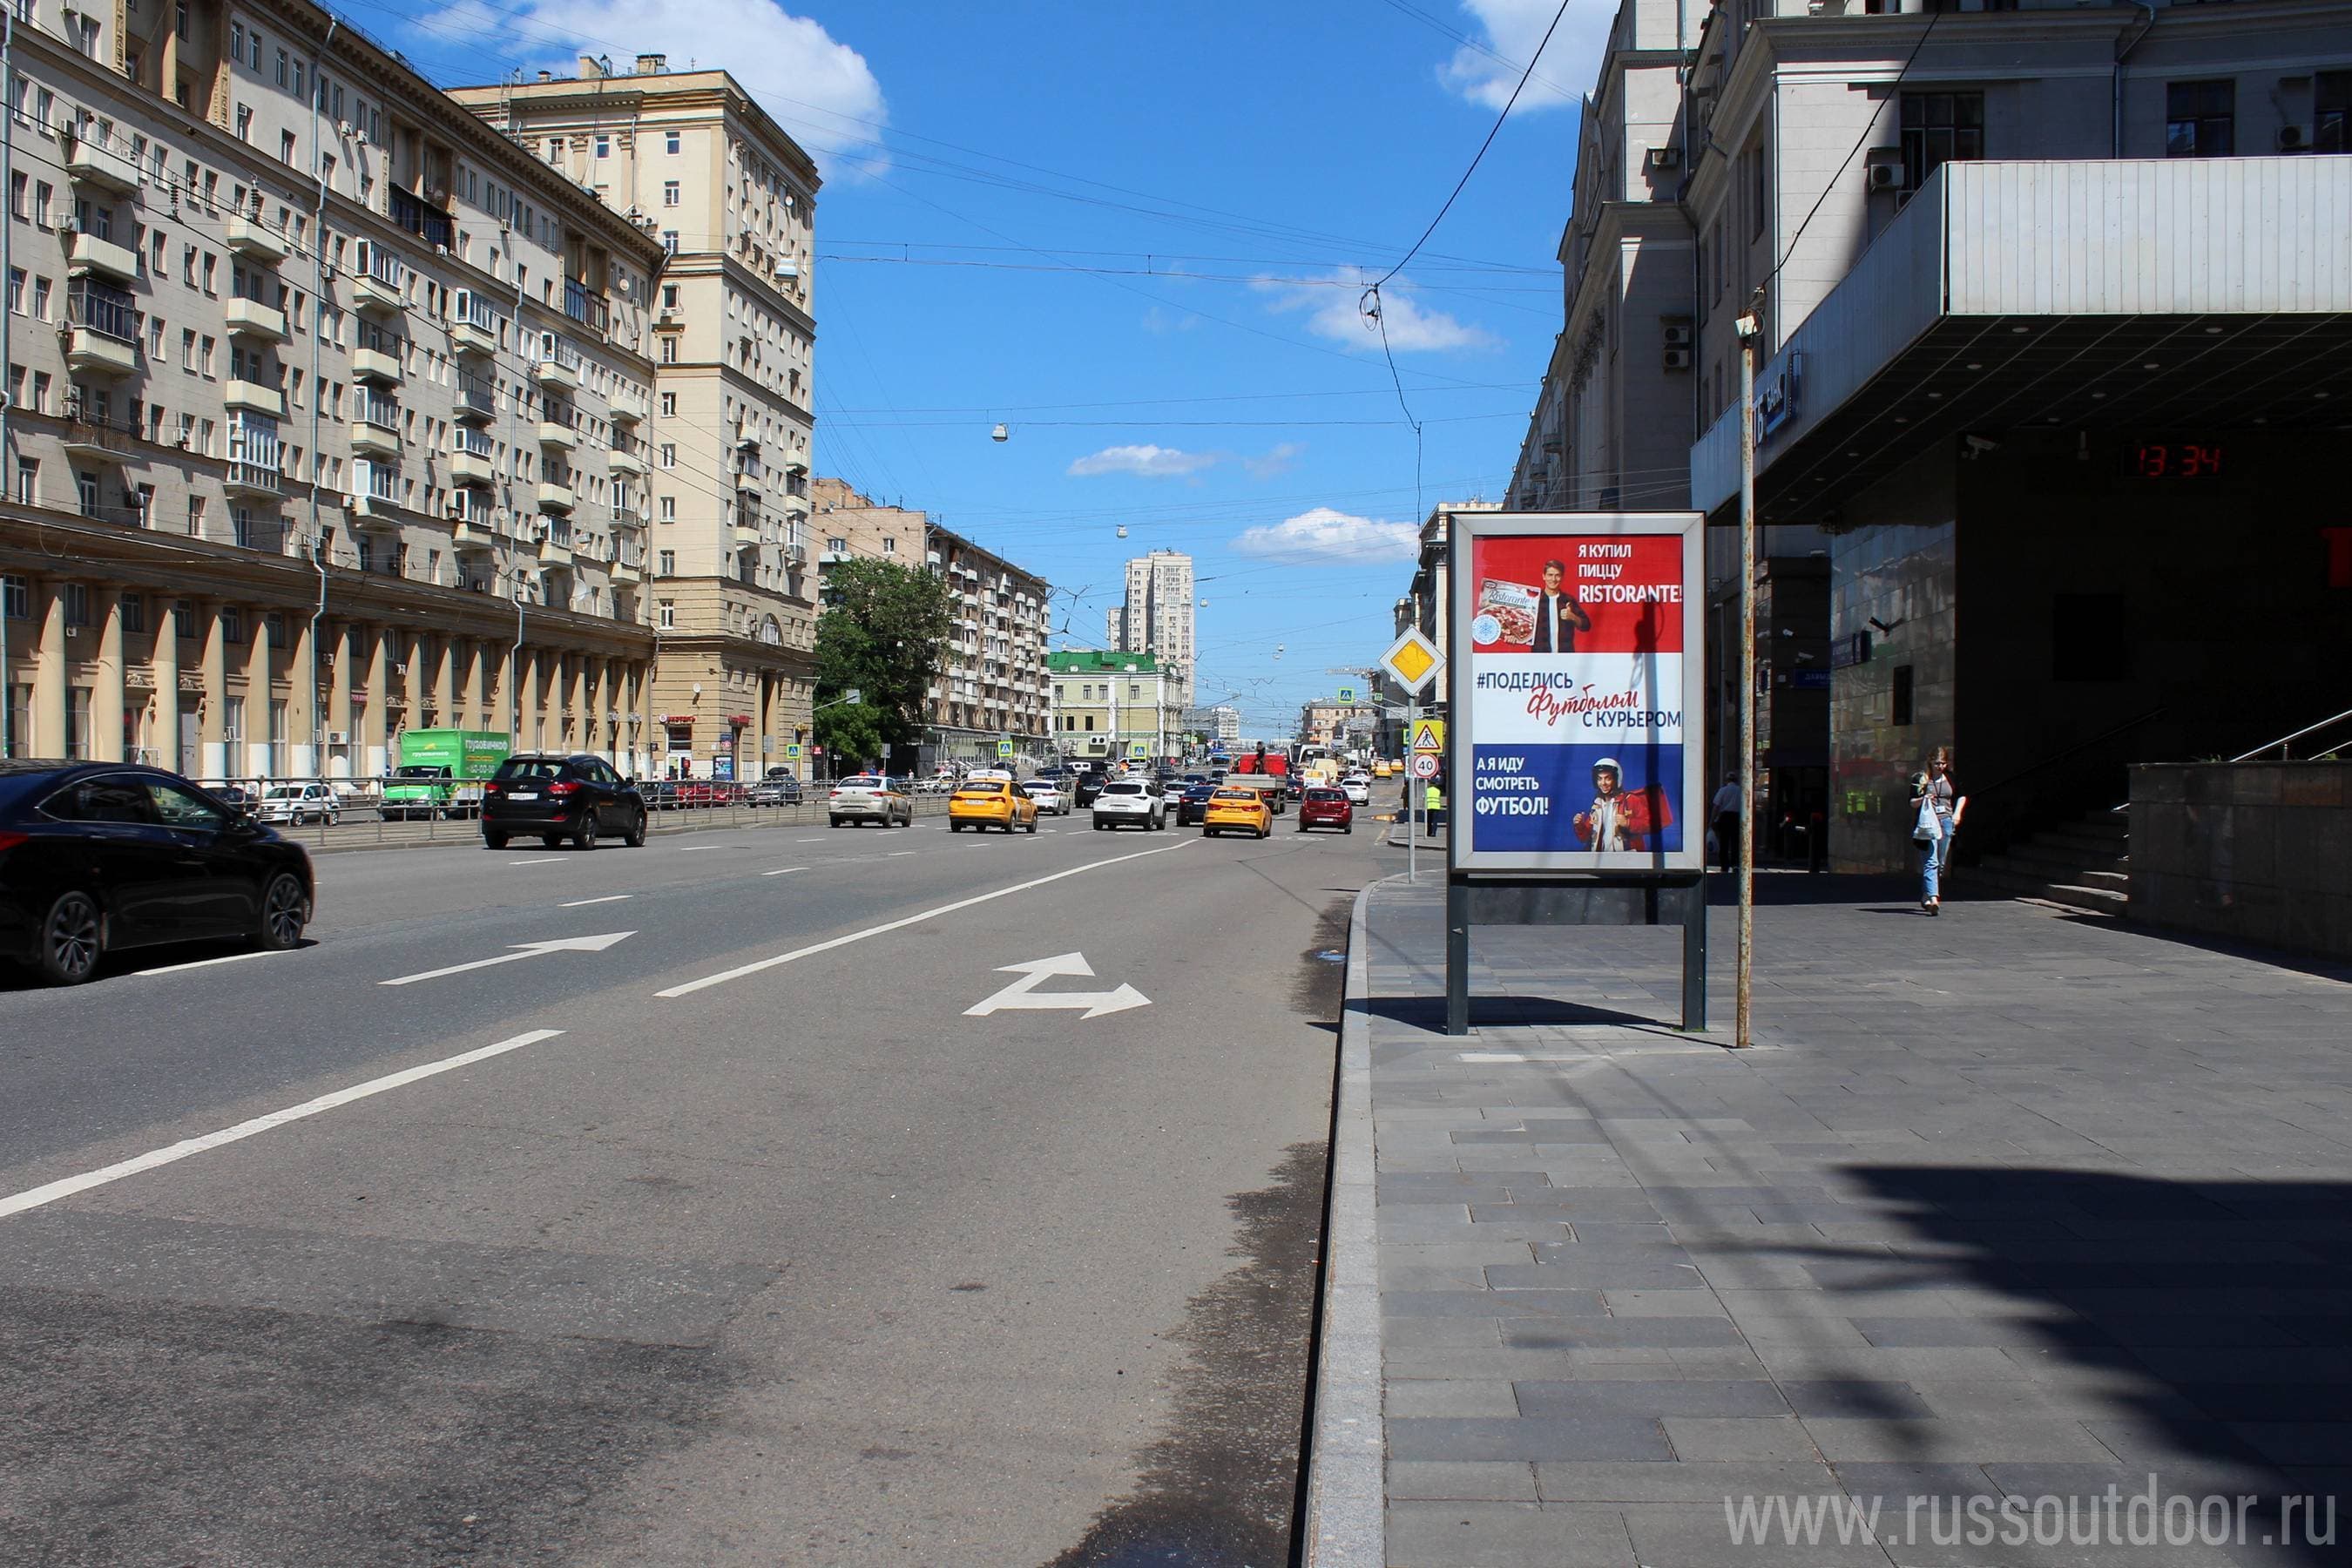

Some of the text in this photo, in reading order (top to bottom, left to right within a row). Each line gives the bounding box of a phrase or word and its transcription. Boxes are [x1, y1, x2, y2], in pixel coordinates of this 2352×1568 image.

[1578, 544, 1632, 558] Я КУПИЛ
[1578, 564, 1623, 579] ПИЦЦУ
[1578, 585, 1683, 604] RISTORANTE!
[1477, 672, 1573, 693] #ПОДЕЛИСЬ
[1526, 683, 1639, 727] Футболом
[1582, 710, 1682, 728] С КУРЬЕРОМ
[1418, 760, 1433, 770] 40
[1477, 757, 1524, 773] А Я ИДУ
[1476, 777, 1539, 791] СМОТРЕТЬ
[1476, 796, 1549, 816] ФУТБОЛ!
